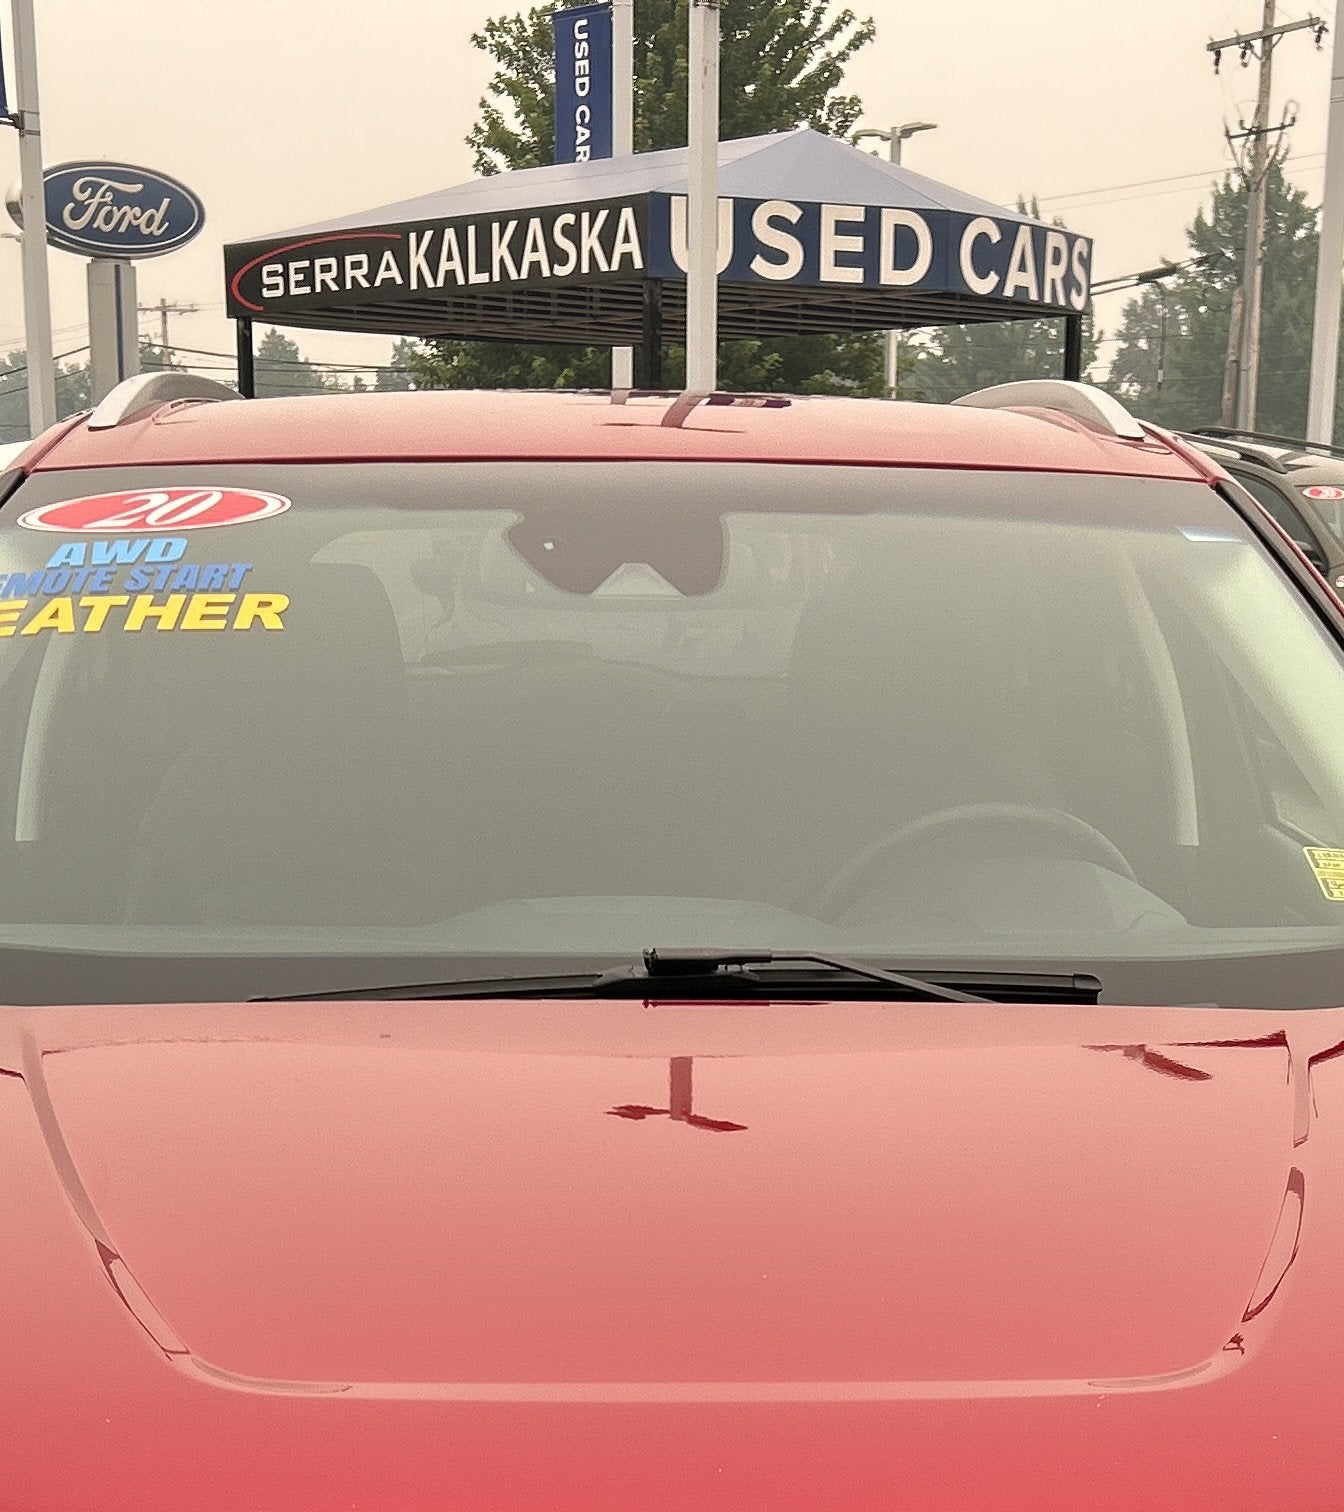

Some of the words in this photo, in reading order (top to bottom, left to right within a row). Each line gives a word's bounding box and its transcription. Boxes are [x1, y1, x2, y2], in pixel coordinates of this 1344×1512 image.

[574, 19, 590, 97] USED
[62, 176, 171, 236] Ford
[261, 250, 405, 299] SERRA
[408, 206, 645, 291] KALKASKA
[669, 195, 934, 286] USED
[959, 216, 1090, 312] CARS
[81, 490, 224, 529] 20
[45, 537, 189, 569] AWD
[123, 562, 254, 594] START
